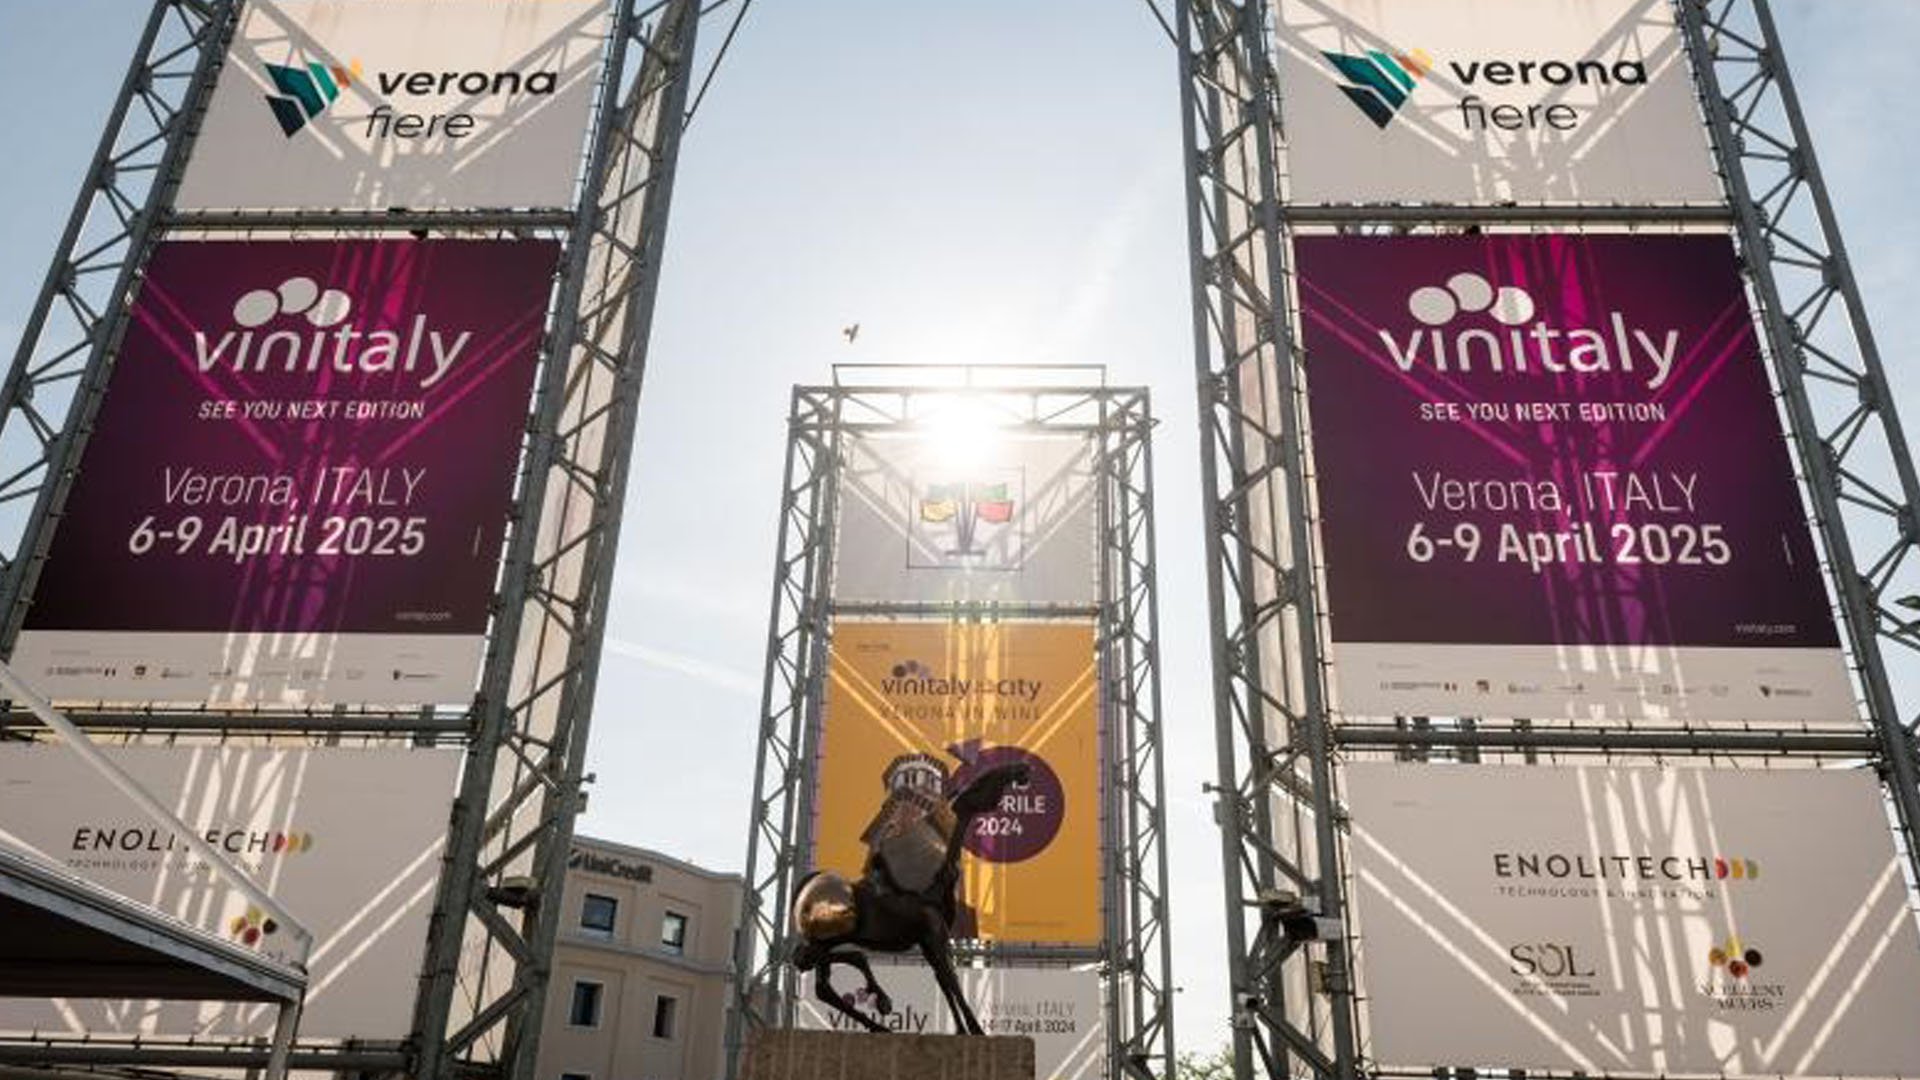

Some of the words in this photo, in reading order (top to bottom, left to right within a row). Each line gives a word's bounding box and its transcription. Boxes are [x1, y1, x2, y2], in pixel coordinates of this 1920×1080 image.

[378, 70, 558, 96] verona
[1449, 60, 1648, 86] verona
[365, 104, 475, 138] fiere
[1456, 95, 1578, 131] fiere
[194, 314, 473, 388] vinitaly
[1378, 311, 1680, 389] vinitaly
[198, 400, 237, 419] SEE
[243, 400, 282, 419] YOU
[286, 400, 340, 419] NEXT
[344, 400, 426, 419] EDITION
[1420, 402, 1461, 420] SEE
[1465, 402, 1509, 421] YOU
[1514, 402, 1572, 421] NEXT
[1579, 402, 1666, 422] EDITION
[164, 467, 299, 510] Verona,
[313, 467, 427, 506] ITALY
[1411, 471, 1572, 515] Verona,
[1582, 471, 1699, 513] ITALY
[128, 515, 203, 555] 6-9
[207, 514, 309, 564] April
[315, 516, 427, 556] 2025
[1406, 522, 1482, 563] 6-9
[1497, 521, 1603, 574] April
[1610, 523, 1732, 566] 2025
[880, 673, 971, 701] vinitaly
[996, 678, 1042, 702] city
[72, 828, 270, 853] ENOLIECH
[975, 816, 1024, 836] 2024
[1493, 853, 1712, 880] ENOLITECH
[1036, 1000, 1077, 1017] ITALY
